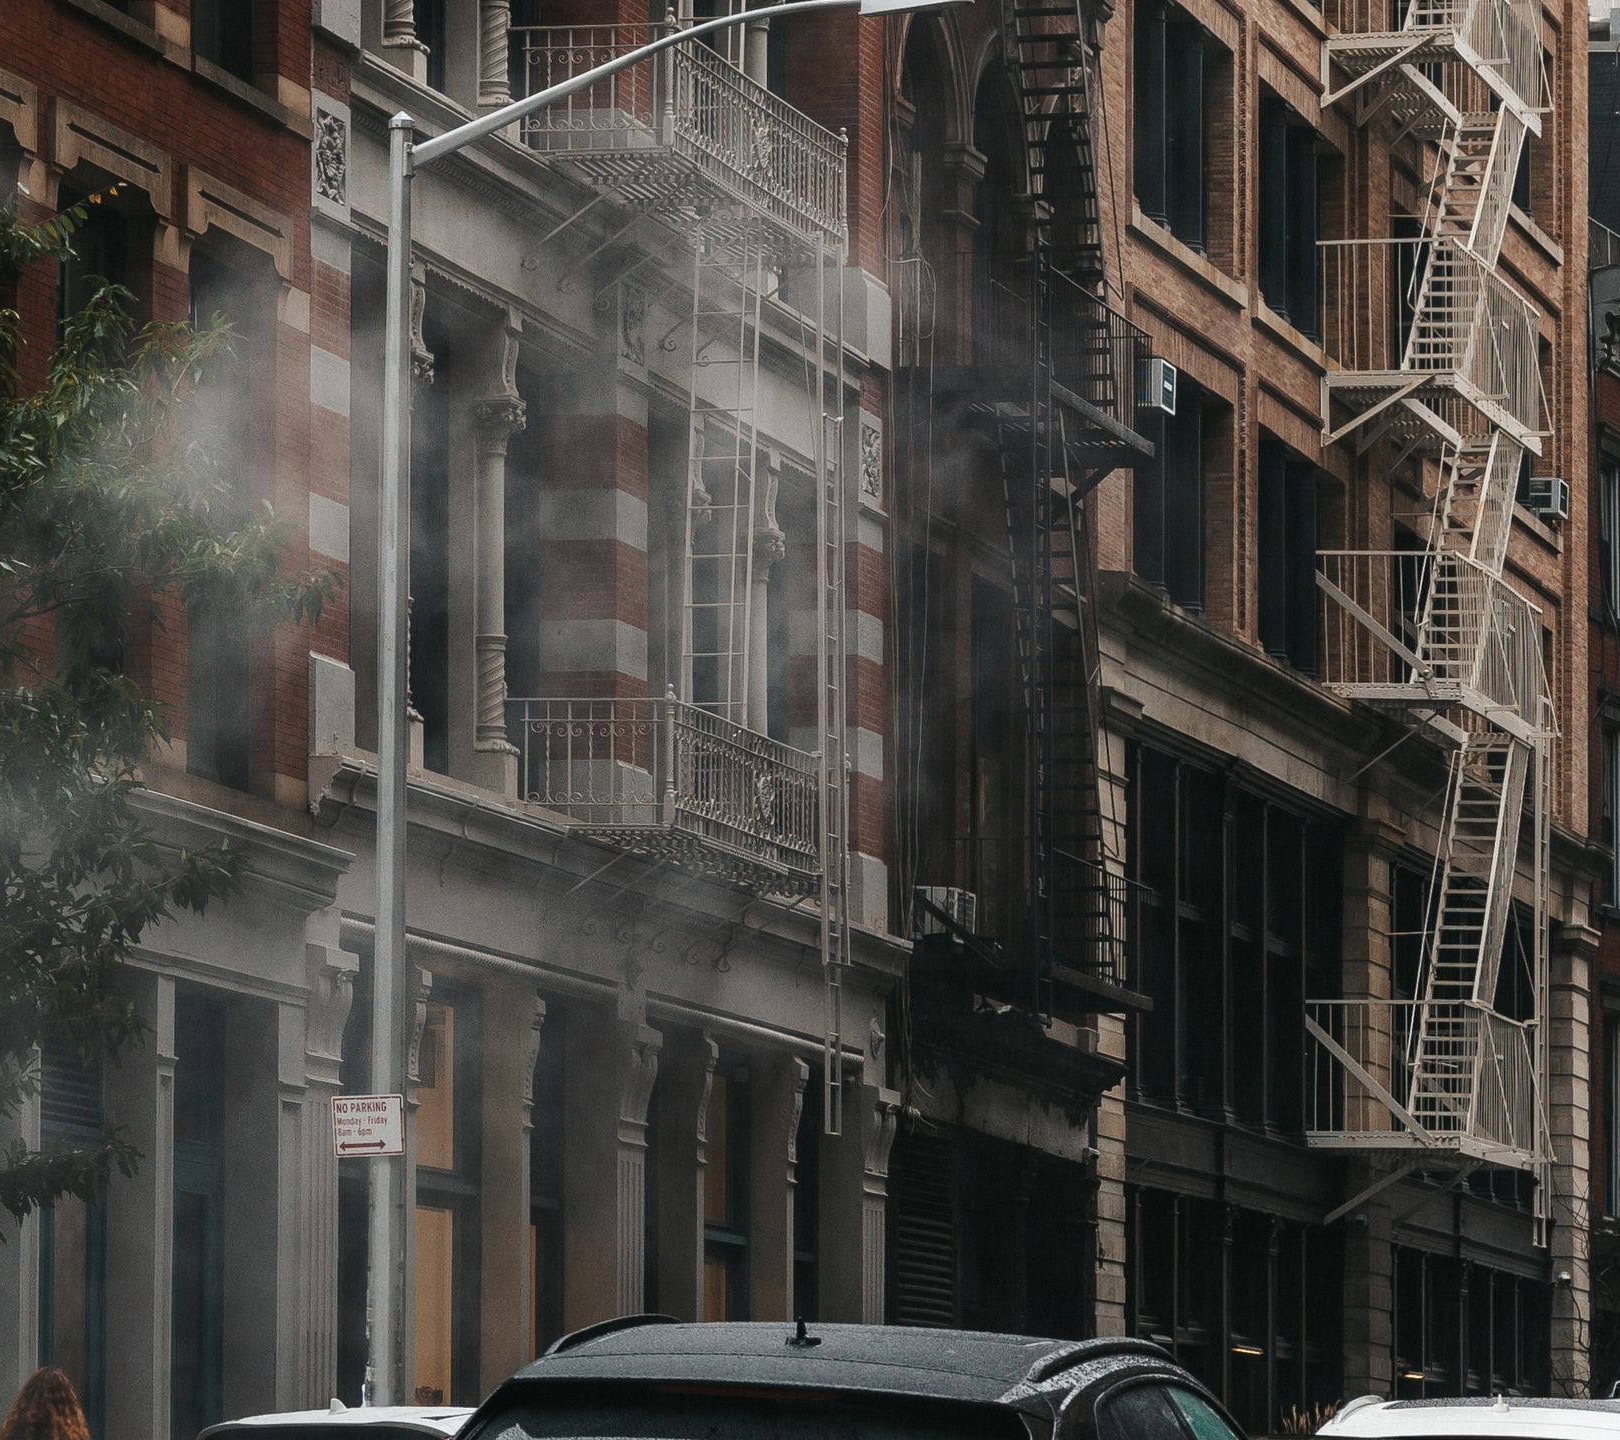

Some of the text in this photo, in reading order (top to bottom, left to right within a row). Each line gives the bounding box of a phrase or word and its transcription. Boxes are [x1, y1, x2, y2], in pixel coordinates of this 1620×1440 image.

[336, 1101, 387, 1113] NO PARKING
[337, 1117, 362, 1126] Monday
[368, 1116, 388, 1125] Friday
[338, 1127, 352, 1137] 8am
[357, 1126, 373, 1136] 6pm
